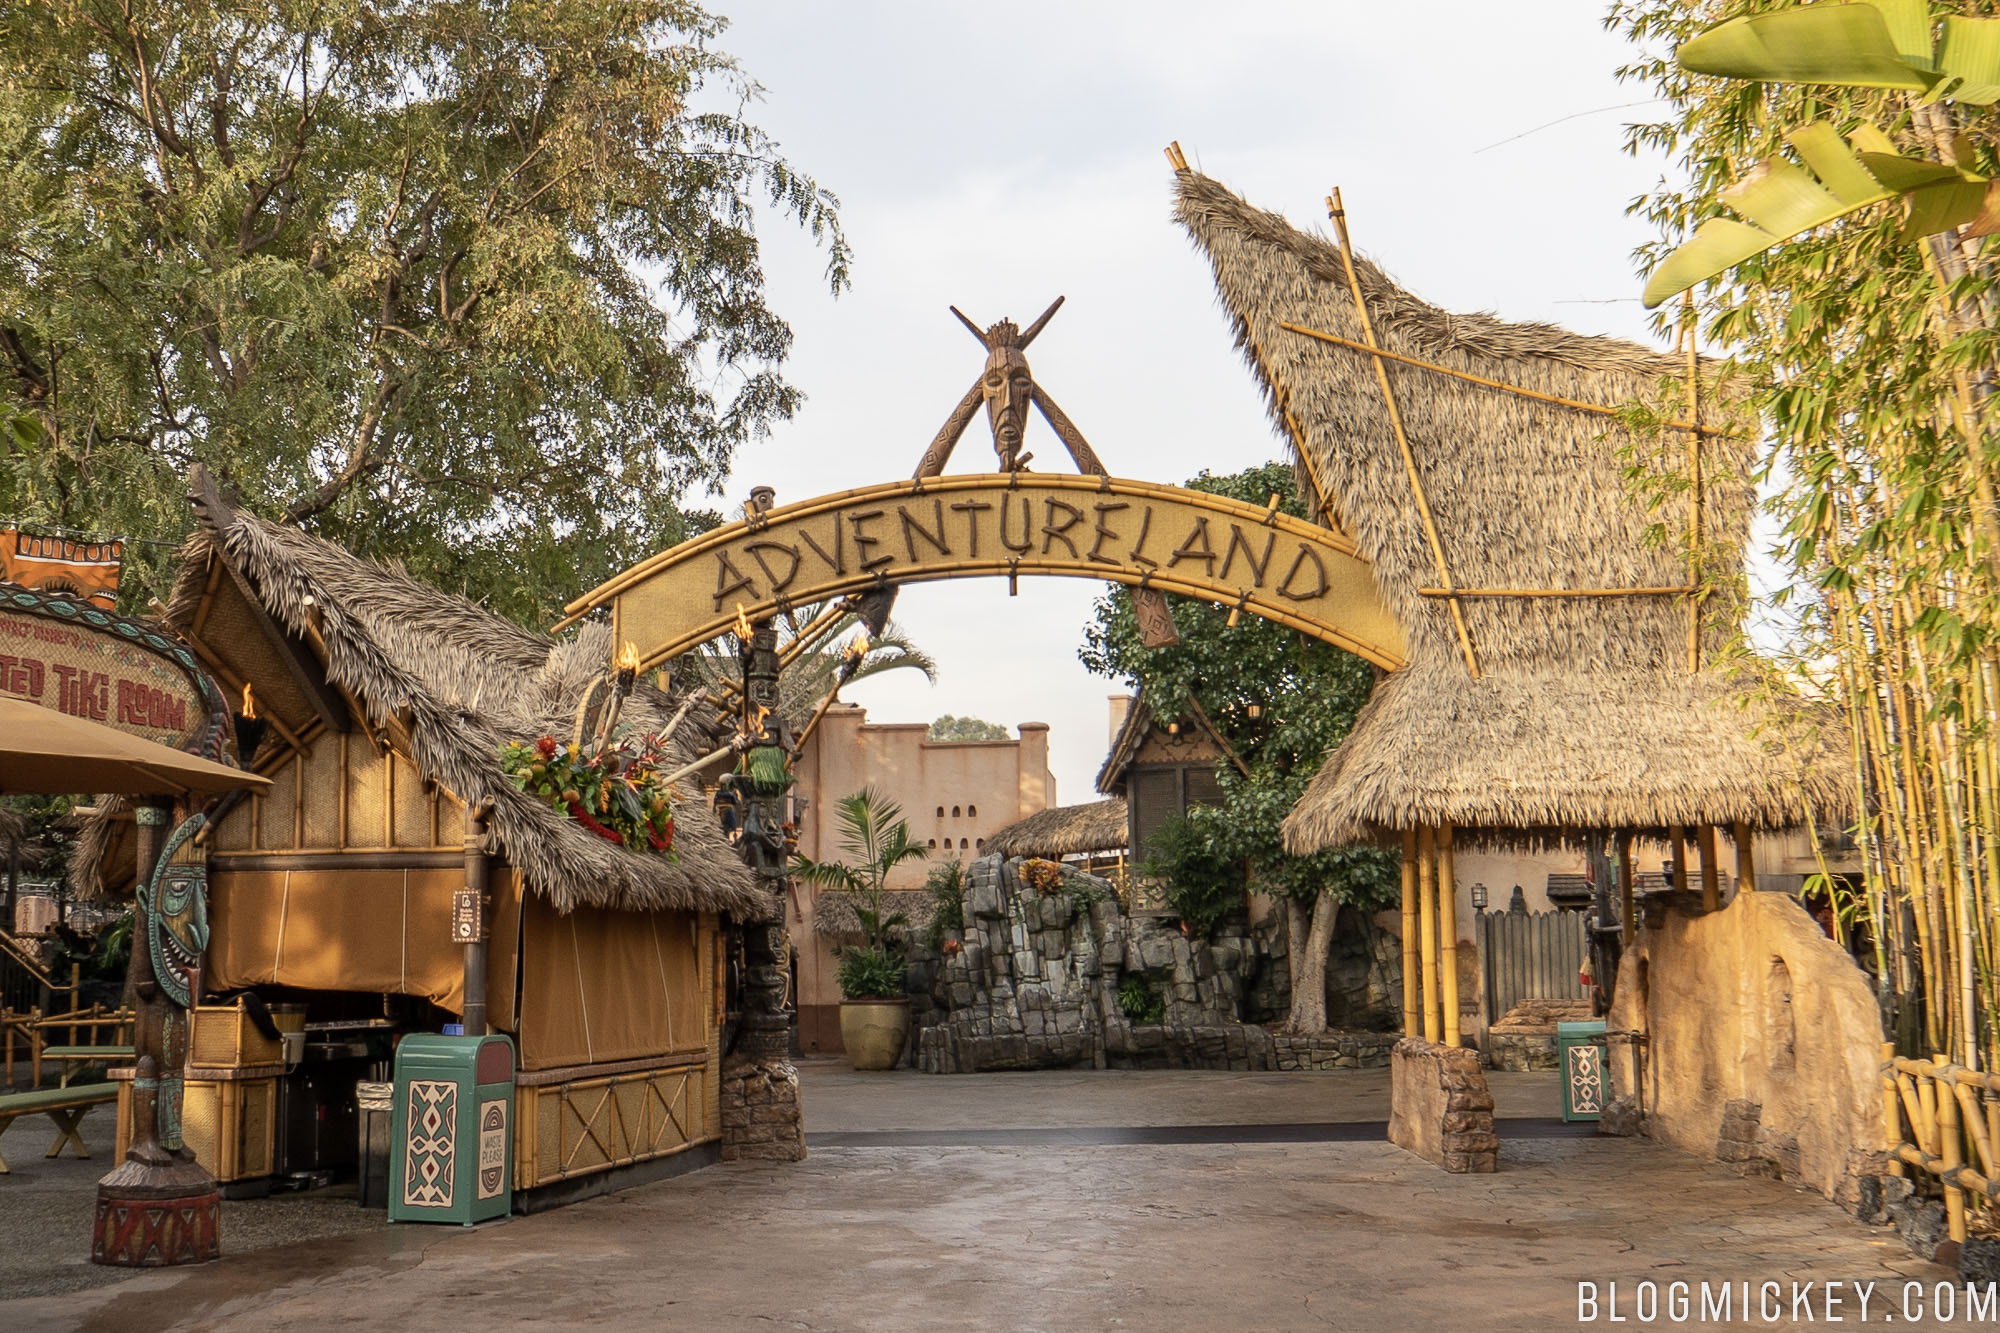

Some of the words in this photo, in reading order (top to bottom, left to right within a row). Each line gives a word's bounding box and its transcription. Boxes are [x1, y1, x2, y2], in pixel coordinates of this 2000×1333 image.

[713, 491, 1330, 613] ADVENTURELAND
[118, 679, 185, 731] ROOM
[482, 1148, 503, 1165] PLEASE
[485, 1134, 502, 1149] WASTE
